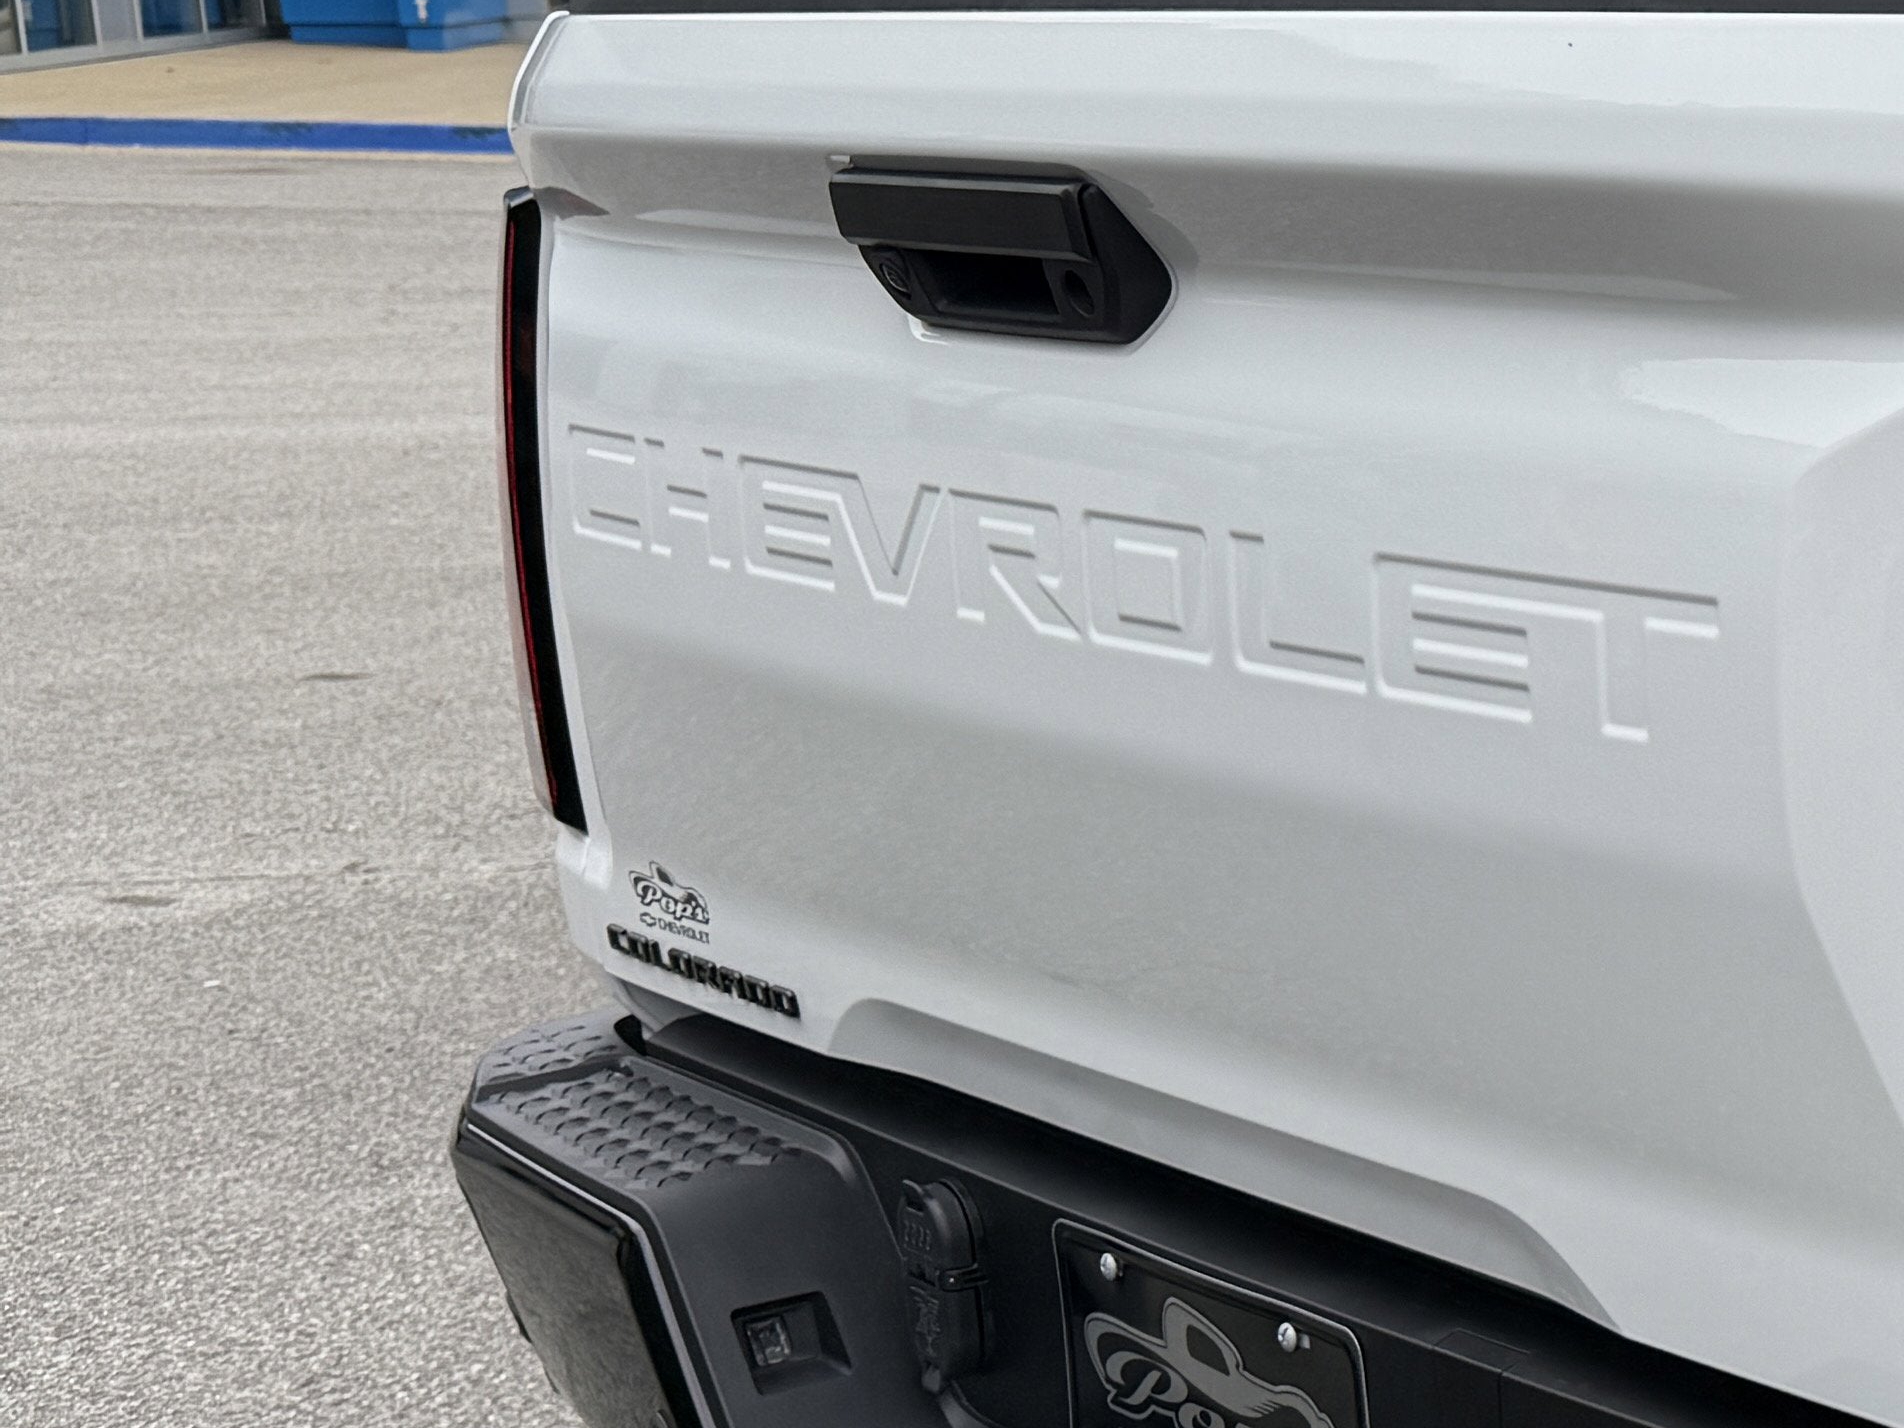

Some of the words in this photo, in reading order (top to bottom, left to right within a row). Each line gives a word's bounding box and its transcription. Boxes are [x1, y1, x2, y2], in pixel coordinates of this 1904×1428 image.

[566, 422, 1720, 743] CHEVROLET
[606, 922, 801, 1020] COLORADO
[657, 918, 711, 945] CHEVROLET
